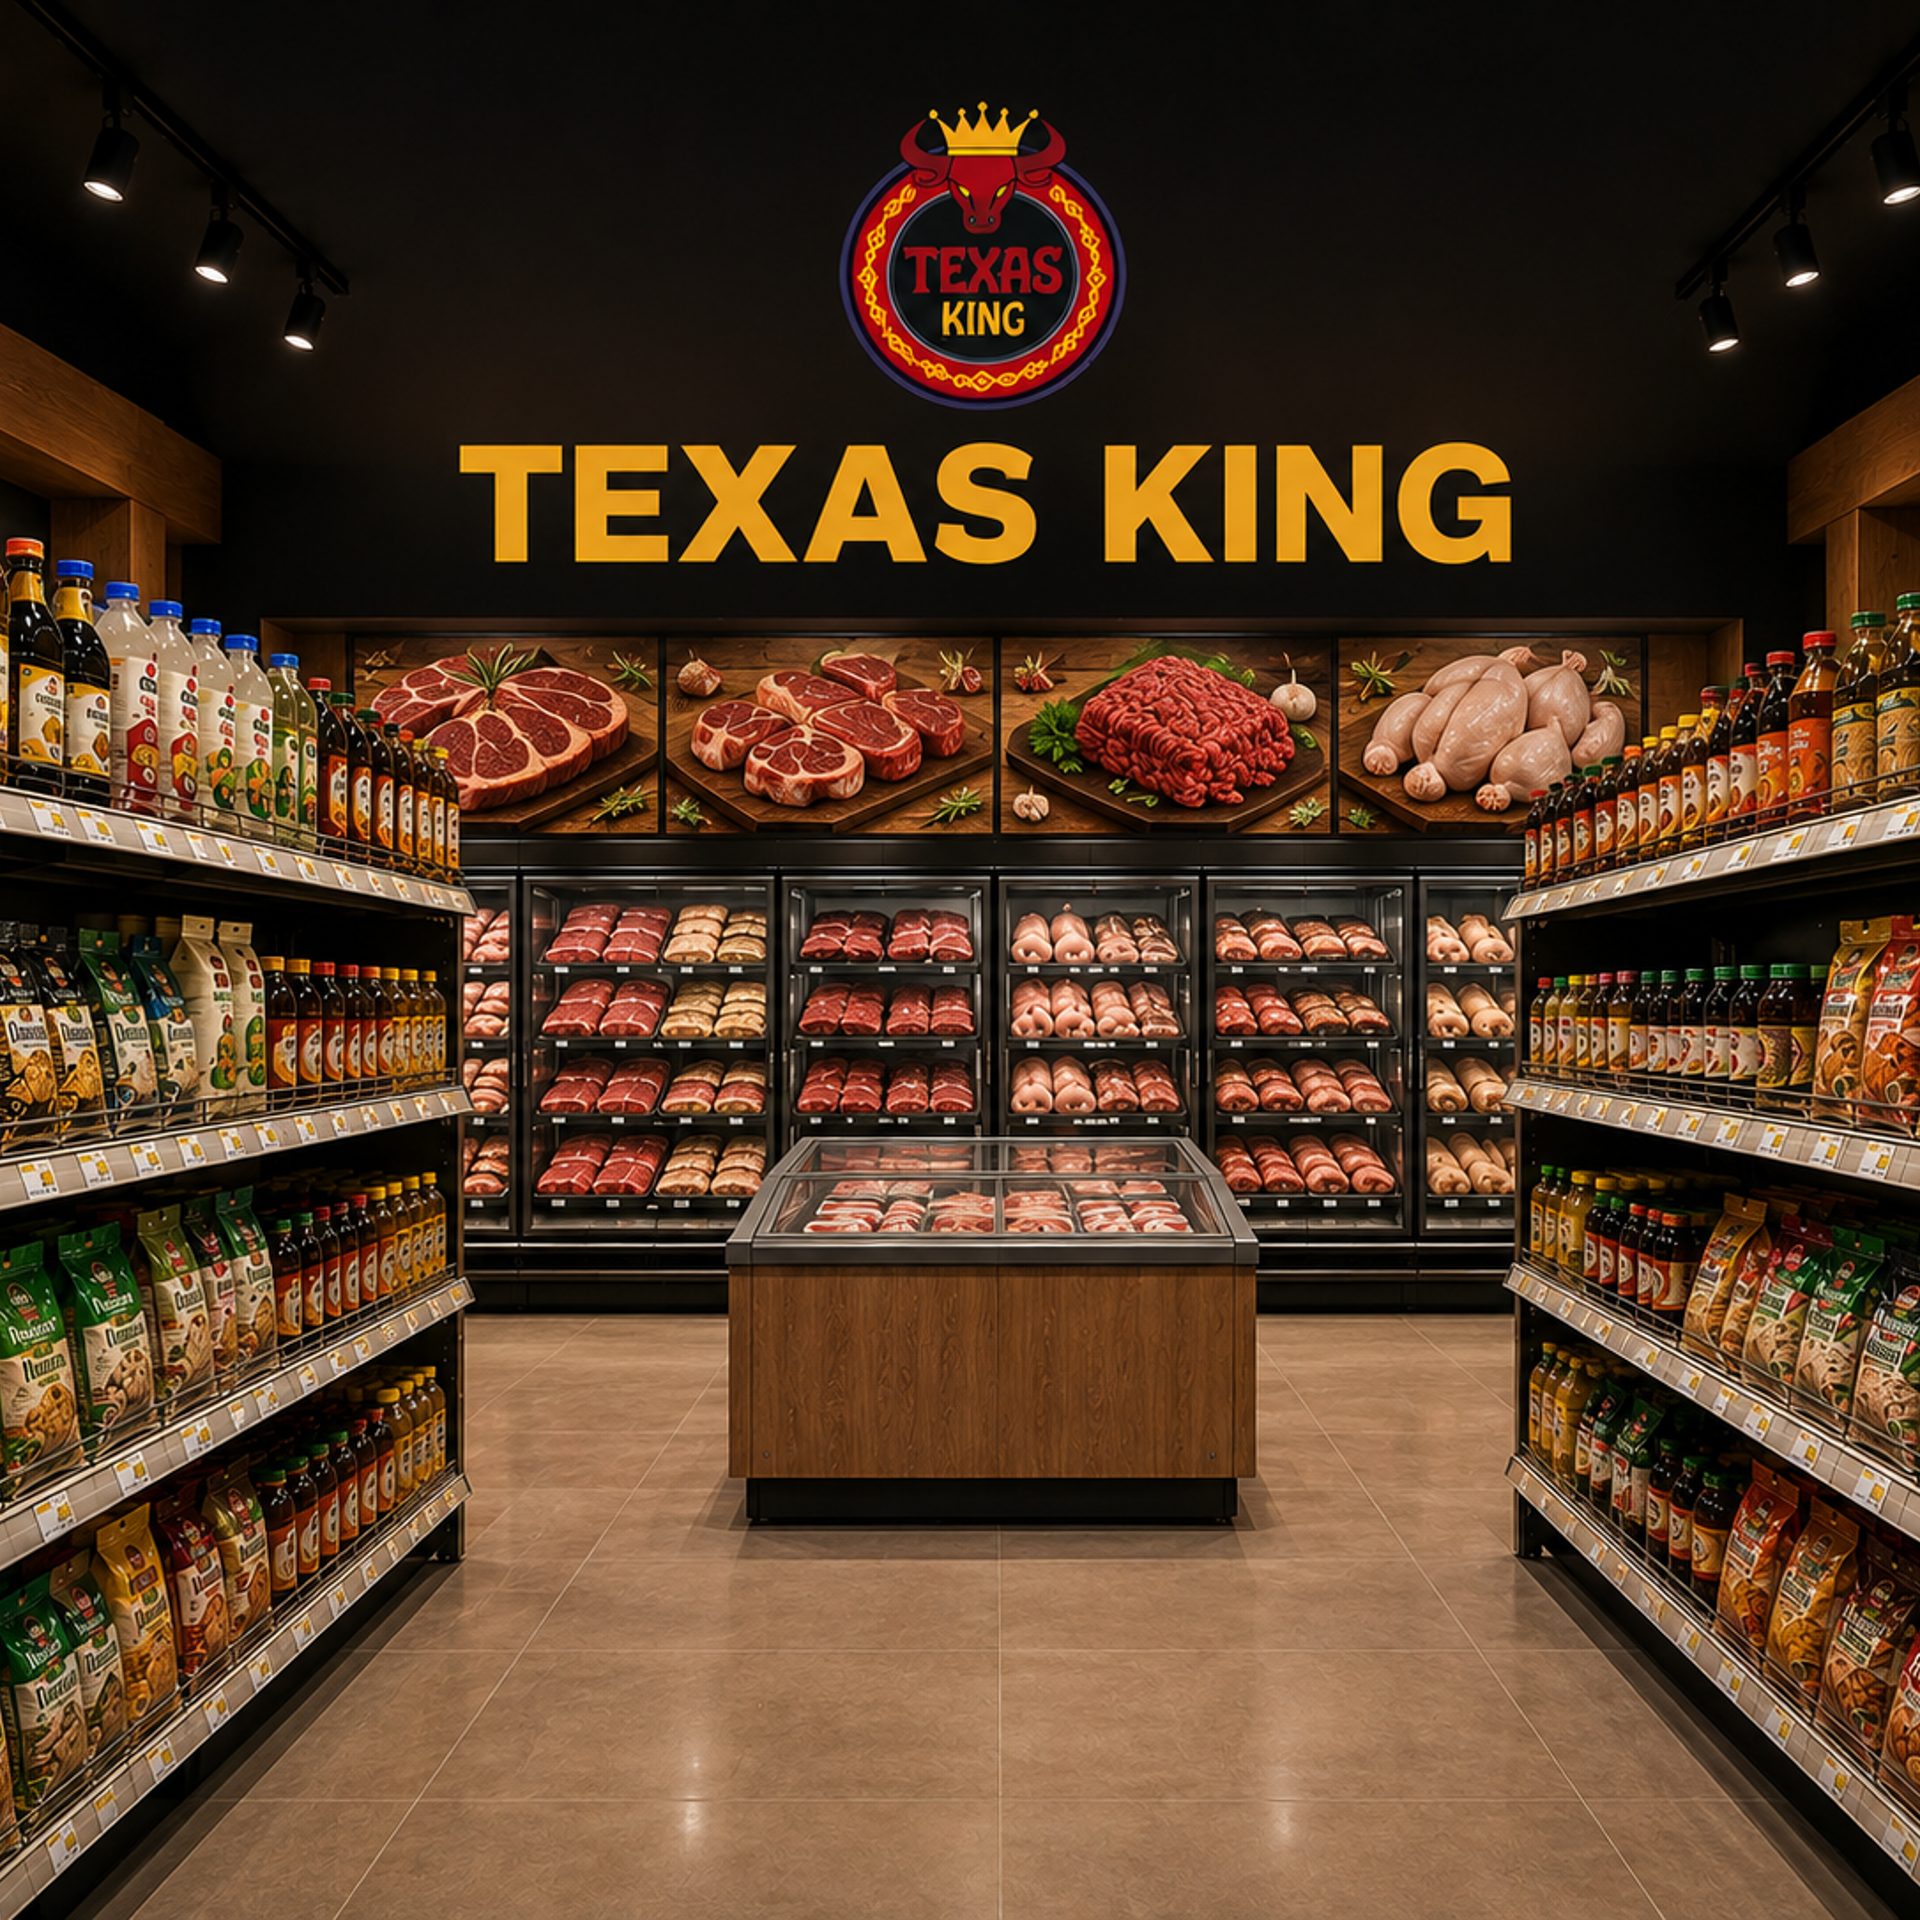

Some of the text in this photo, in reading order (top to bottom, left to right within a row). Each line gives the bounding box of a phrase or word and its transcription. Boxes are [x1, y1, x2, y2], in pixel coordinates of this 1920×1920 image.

[903, 246, 1063, 294] TEXAS
[942, 301, 1025, 336] KING
[459, 443, 1512, 565] TEXAS KING
